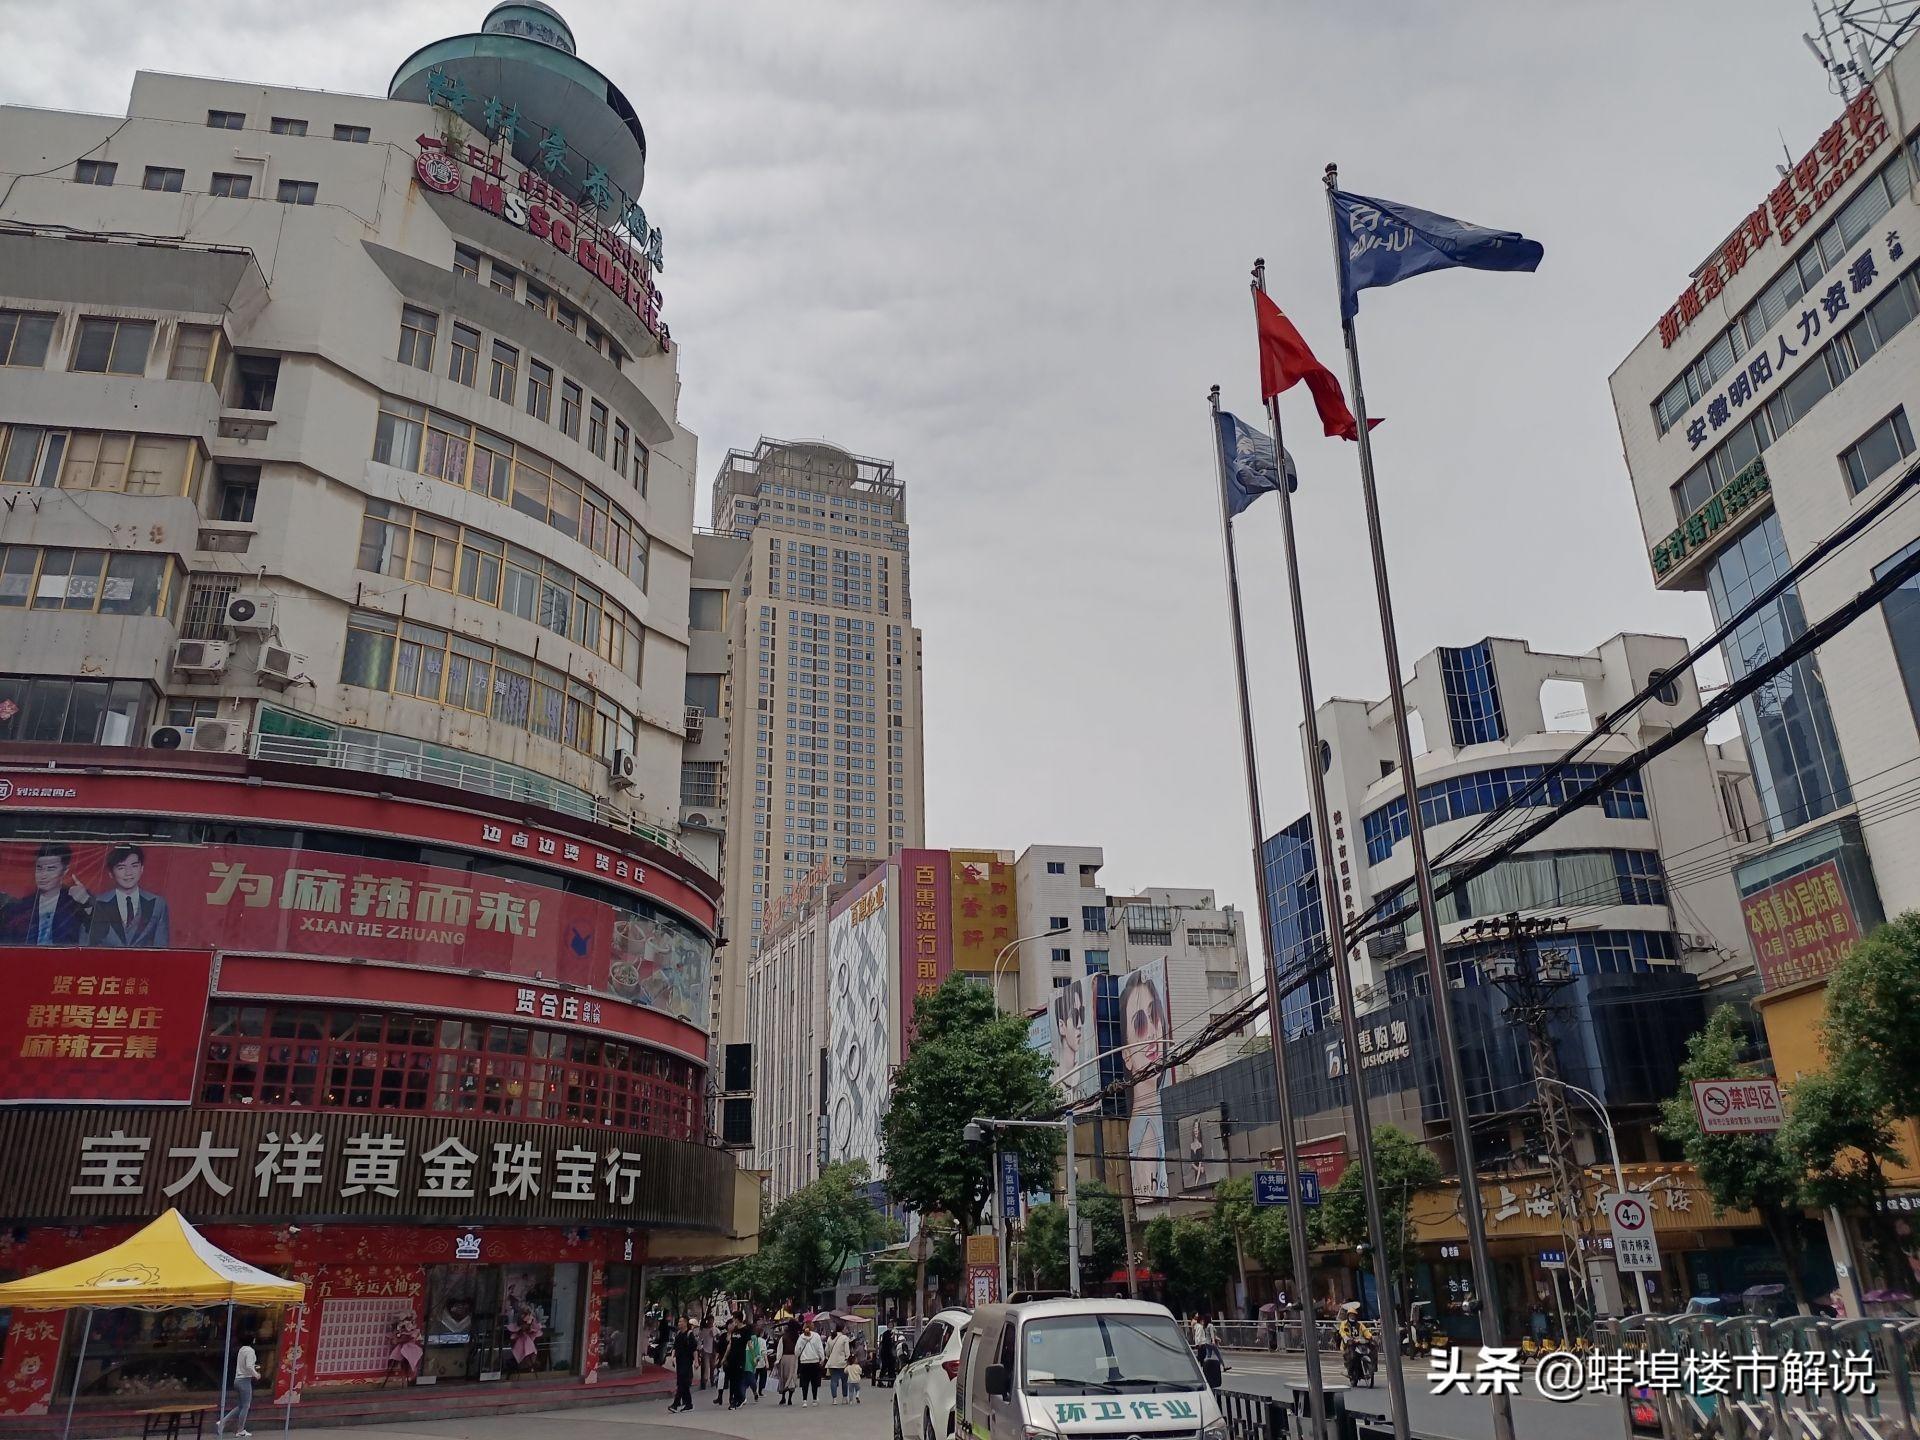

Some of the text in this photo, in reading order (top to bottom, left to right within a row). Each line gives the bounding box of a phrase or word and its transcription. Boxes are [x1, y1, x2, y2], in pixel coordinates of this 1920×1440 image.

[578, 239, 660, 334] COFFEE
[1685, 249, 1879, 452] 安徽明阳人力资源
[1653, 494, 1728, 575] 会计培训
[482, 824, 646, 884] 边卤边烫 贤合庄
[206, 861, 542, 938] 为麻辣而来!
[850, 883, 885, 929] 百惠企业
[300, 917, 465, 946] XIAN HE ZHUANG
[51, 975, 122, 996] 贤合庄
[26, 1004, 164, 1029] 群贤坐庄
[516, 988, 580, 1020] 贤合庄
[20, 1034, 158, 1059] 麻辣云集
[1341, 1019, 1408, 1060] 惠购物
[1728, 1086, 1777, 1111] 禁鸣区
[70, 1130, 642, 1206] 宝大祥黄金珠宝行
[1004, 1154, 1016, 1217] 电子监控路段
[1268, 1185, 1285, 1193] Toilet
[1622, 1208, 1639, 1221] 4m
[1620, 1239, 1651, 1251] 前方桥梁
[1623, 1253, 1654, 1265] 限高4米
[353, 1277, 422, 1297] 幸运大抽奖
[1054, 1399, 1198, 1424] 环卫作业
